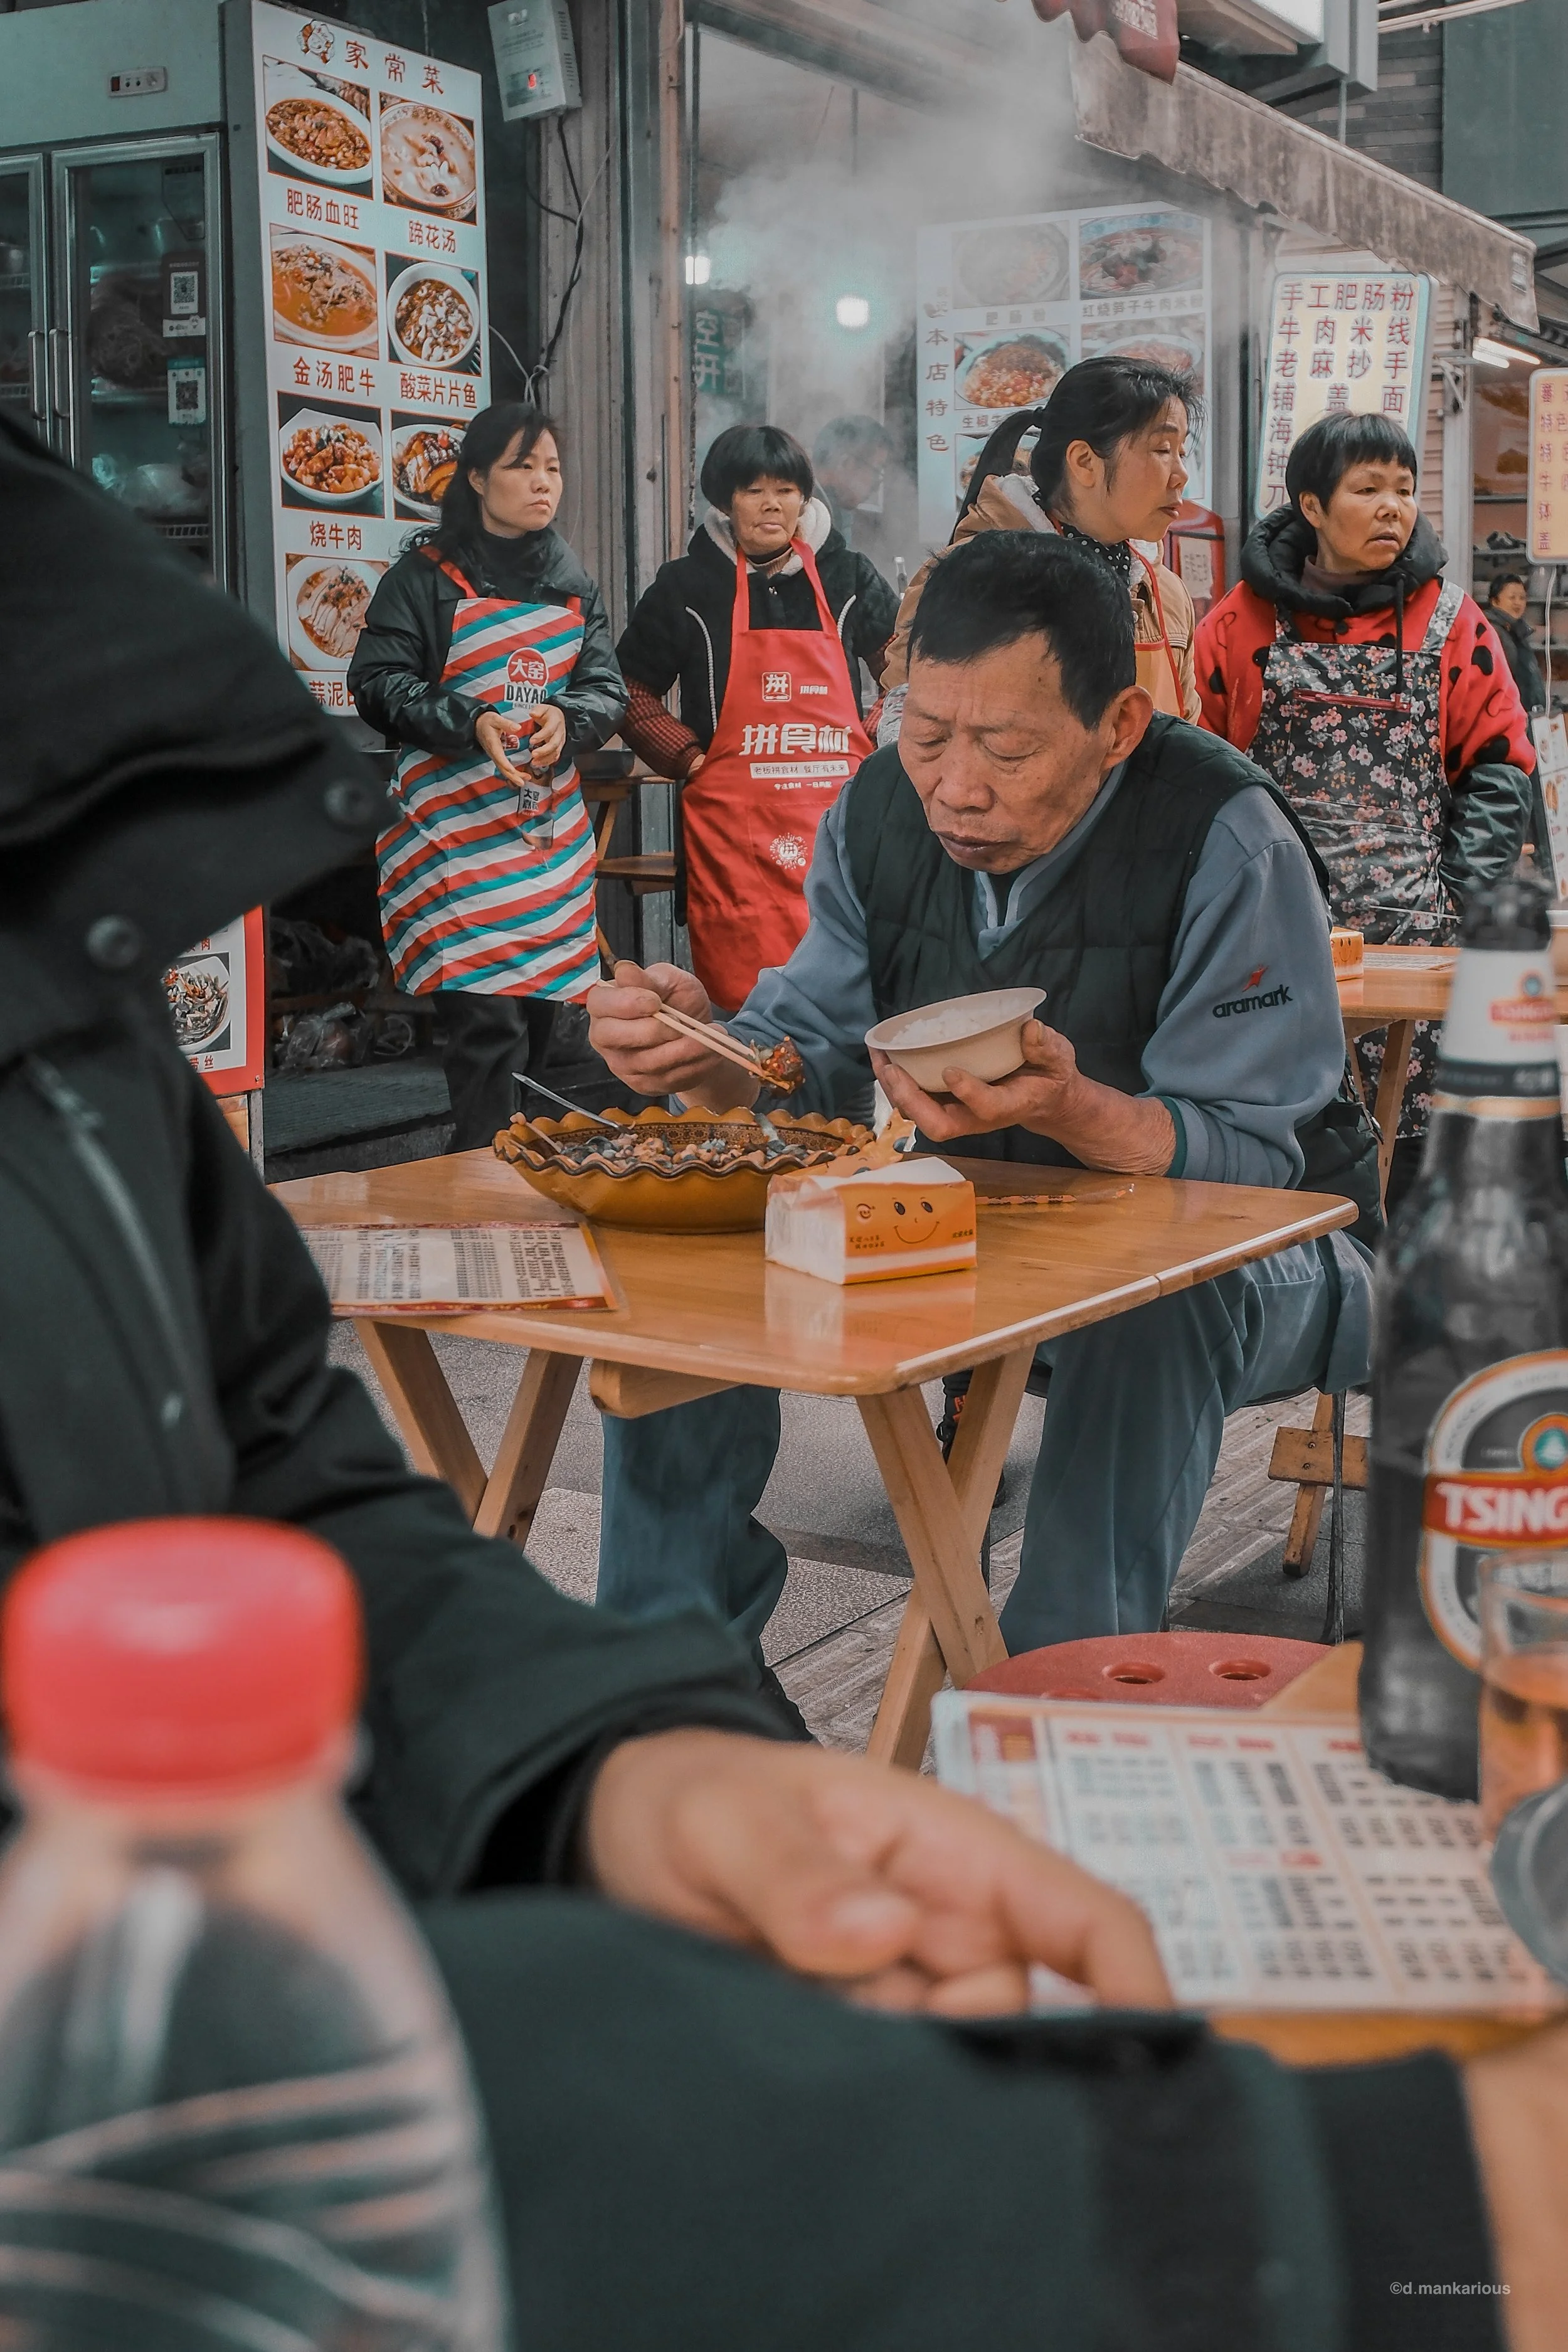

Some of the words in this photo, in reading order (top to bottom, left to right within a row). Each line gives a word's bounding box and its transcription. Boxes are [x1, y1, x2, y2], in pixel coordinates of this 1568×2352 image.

[345, 40, 444, 94] 家常菜
[287, 188, 359, 230] 肥肠血旺
[408, 220, 456, 253] 蹄花汤
[1281, 282, 1414, 311] 手工肥肠粉
[1278, 315, 1410, 346] 牛肉米线
[293, 356, 375, 396] 金汤肥牛
[1275, 349, 1408, 379] 老麻抄手
[400, 371, 477, 408] 酸菜片片鱼
[925, 327, 949, 451] 本店特色
[1273, 381, 1406, 413] 铺盖面
[310, 520, 361, 550] 烧牛肉
[511, 659, 544, 680] 大窑
[739, 723, 853, 755] 拼食材
[1212, 984, 1293, 1018] aramark
